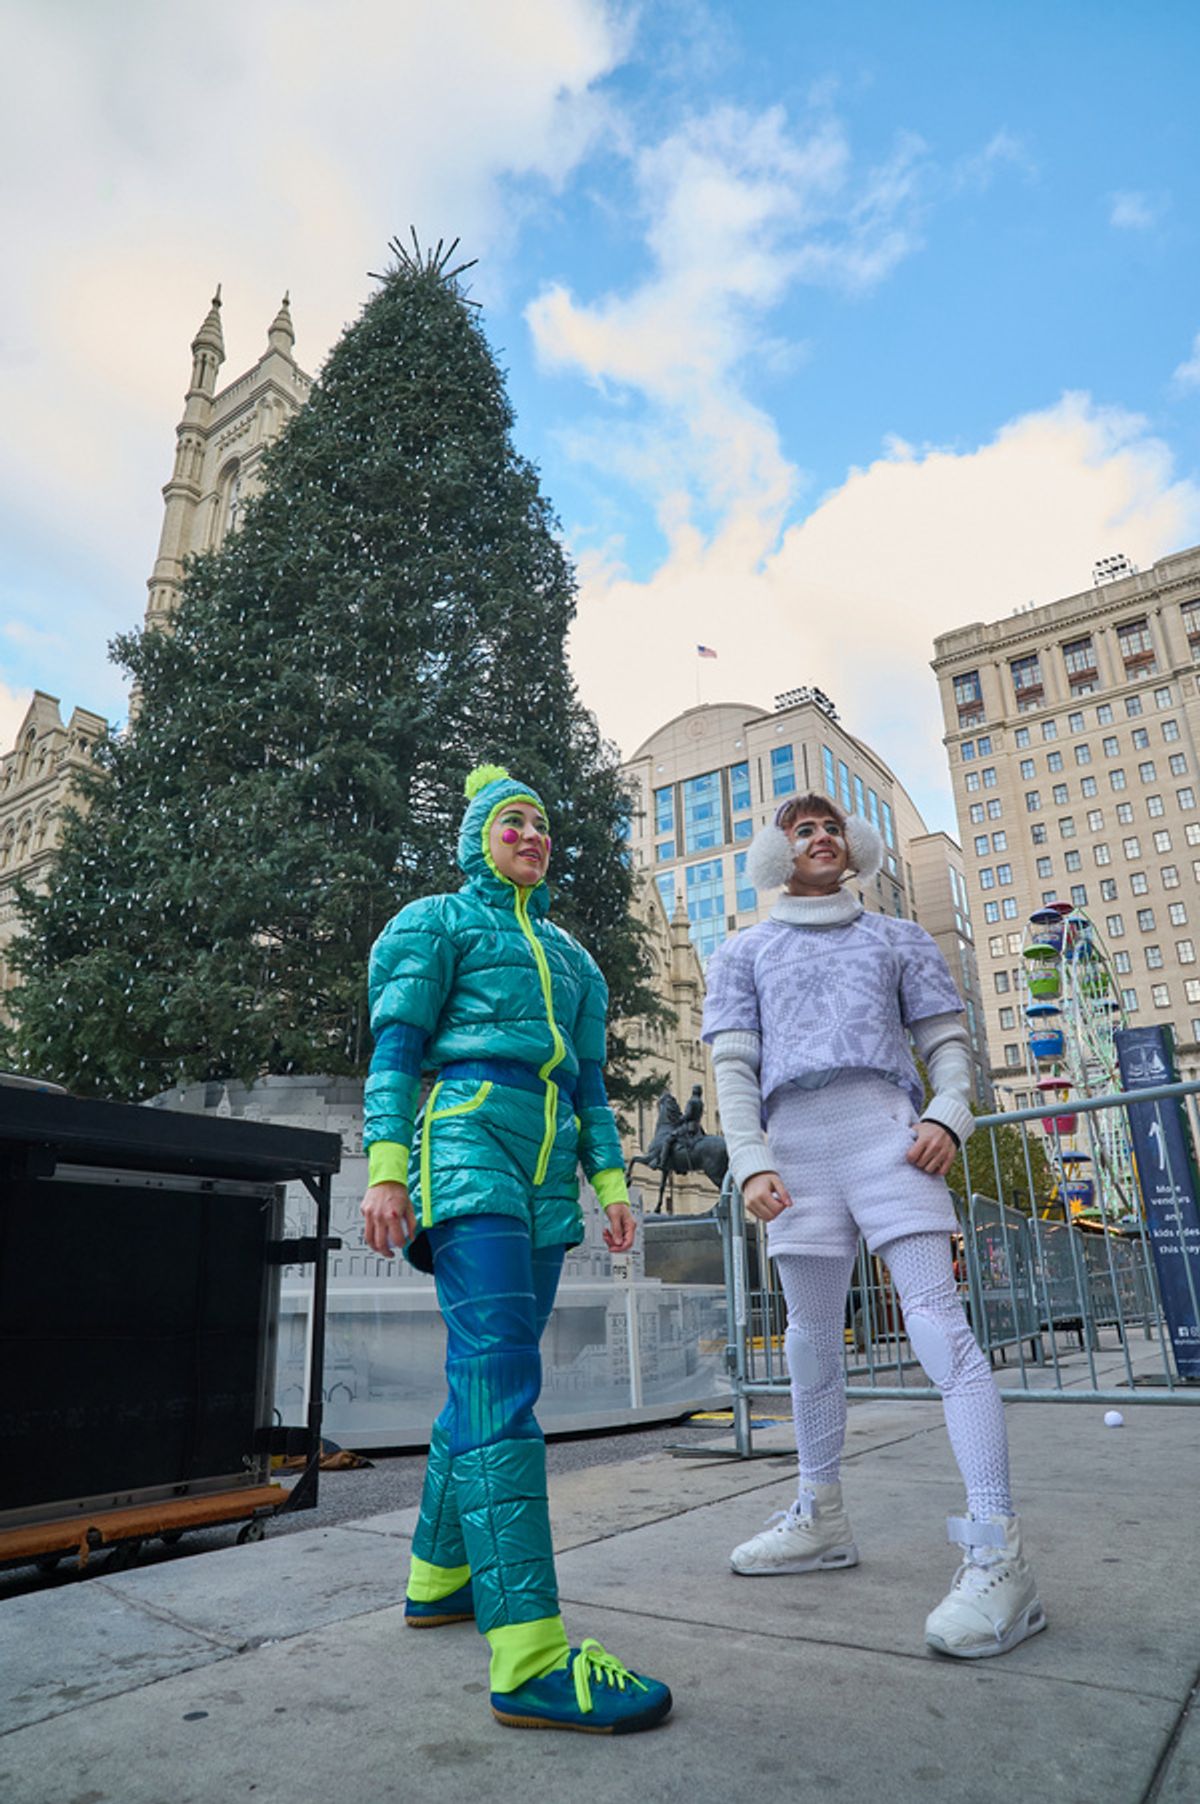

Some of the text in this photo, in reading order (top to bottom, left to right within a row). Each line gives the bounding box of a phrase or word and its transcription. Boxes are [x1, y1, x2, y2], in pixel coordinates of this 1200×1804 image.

[1153, 1227, 1200, 1237] kids rdes
[1159, 1245, 1179, 1254] this
